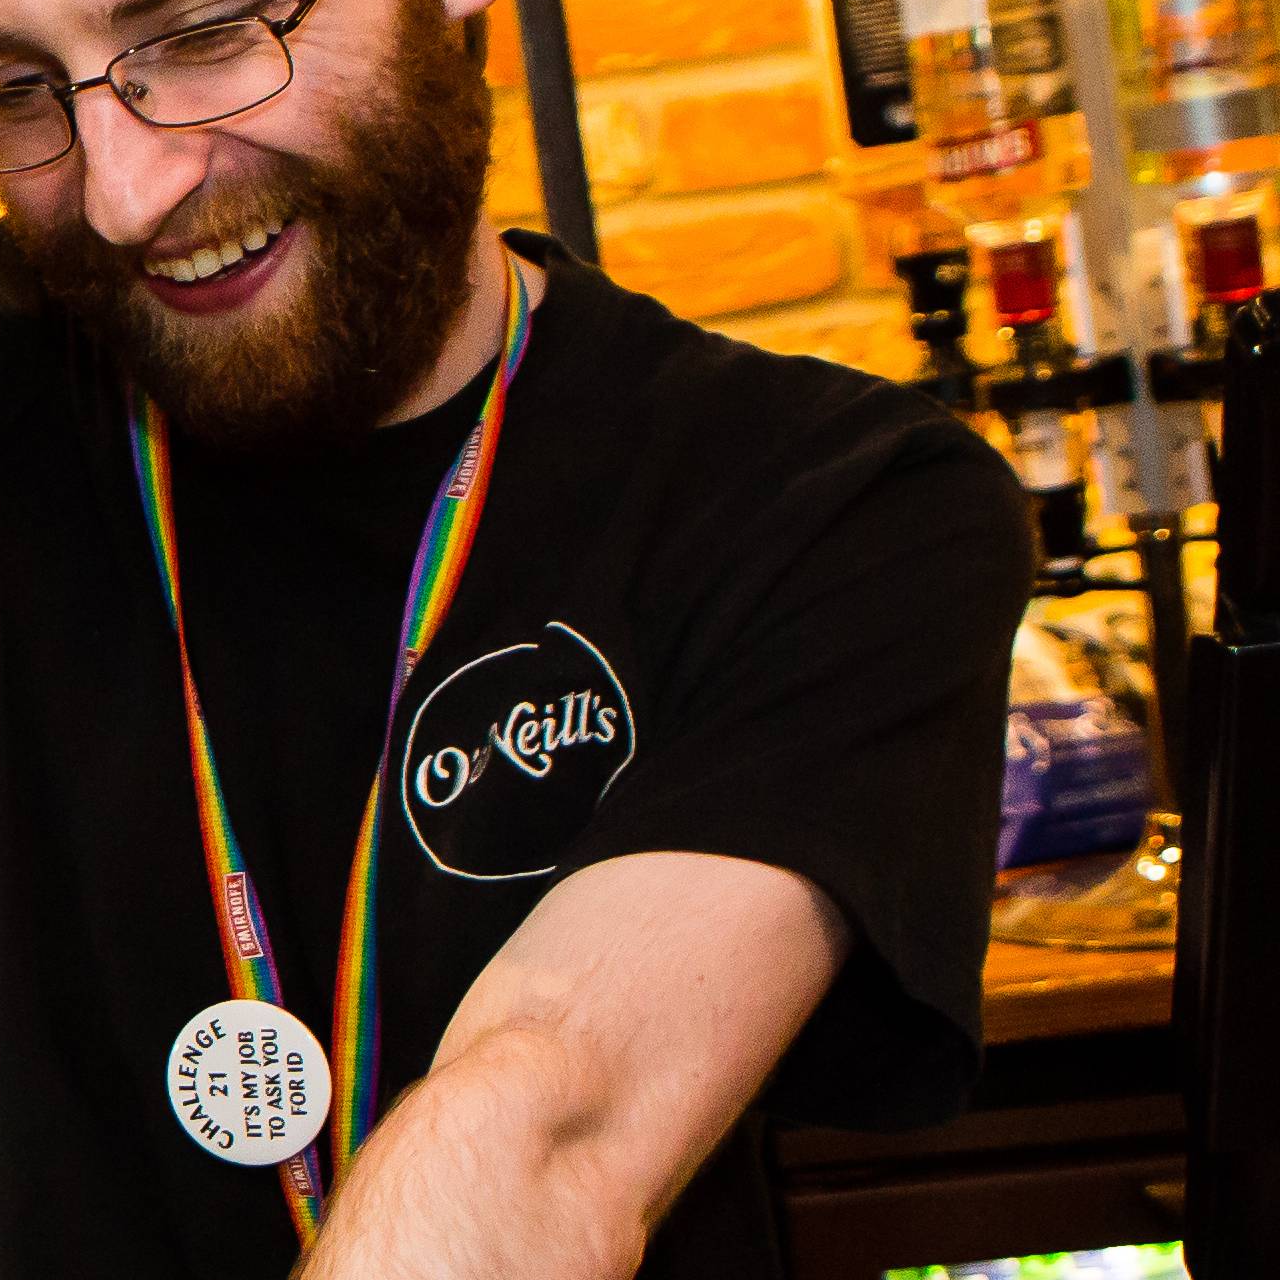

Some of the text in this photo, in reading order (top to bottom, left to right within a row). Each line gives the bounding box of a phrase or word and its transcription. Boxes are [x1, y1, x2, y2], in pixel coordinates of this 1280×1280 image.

[416, 689, 618, 807] O'Neill's
[227, 877, 257, 953] SMIRNOFF
[178, 1018, 234, 1149] CHALLENGE
[208, 1072, 229, 1097] 21
[238, 1030, 263, 1138] IT'S MY JOB
[261, 1028, 286, 1140] TO ASK YOU
[286, 1051, 308, 1116] FOR ID
